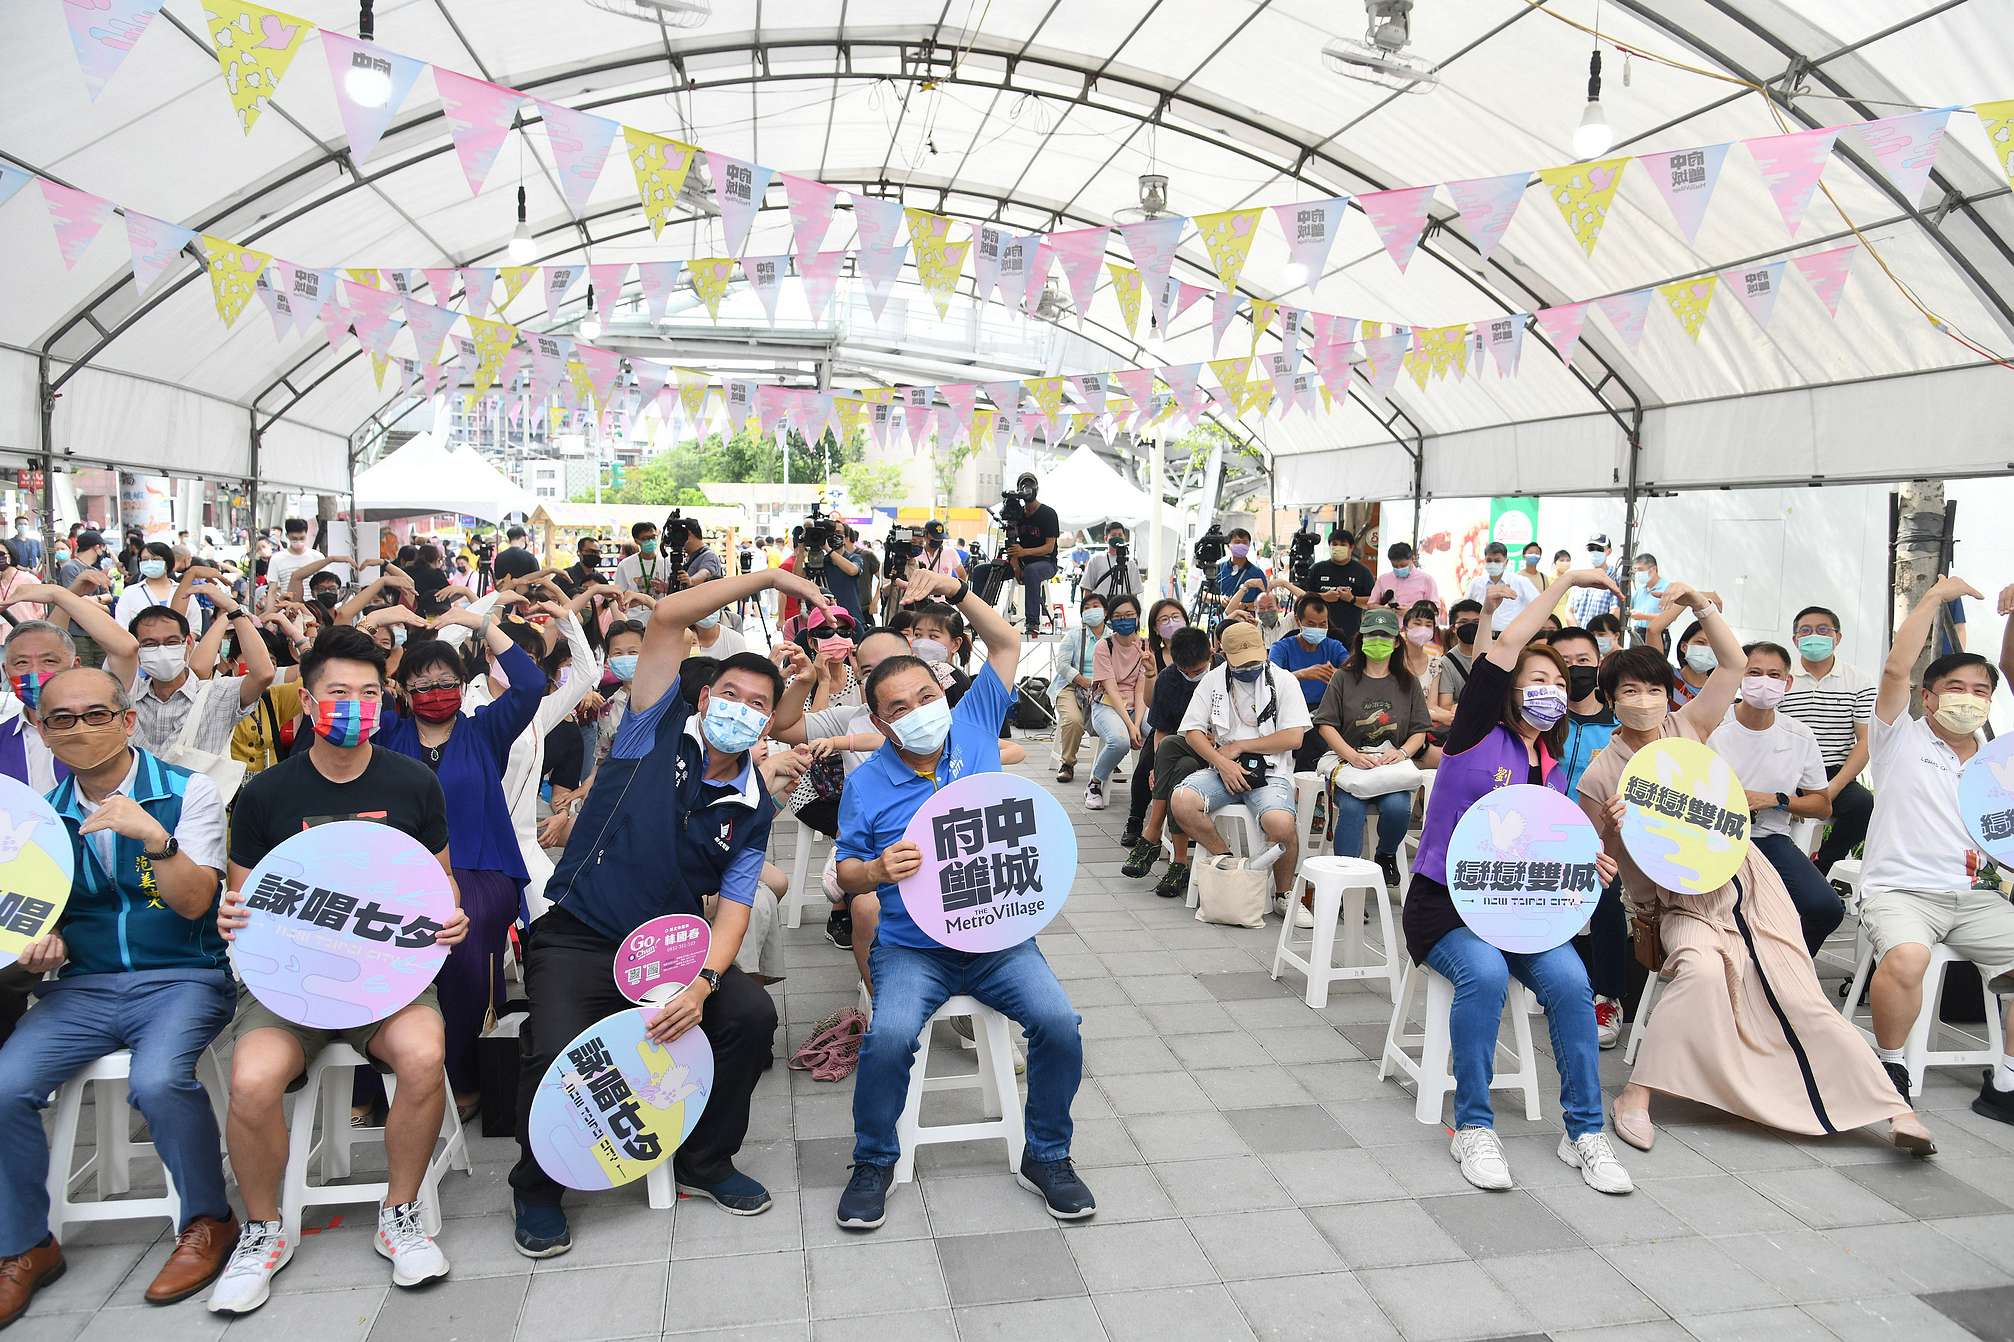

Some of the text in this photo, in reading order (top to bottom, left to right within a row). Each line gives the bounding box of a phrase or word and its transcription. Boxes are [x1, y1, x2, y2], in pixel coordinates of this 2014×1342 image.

[932, 798, 1036, 861] 府中
[1624, 776, 1747, 840] 戀戀雙城
[939, 846, 1043, 912] 雙城
[1453, 860, 1598, 892] 戀戀雙城
[246, 873, 446, 948] 詠唱七夕
[567, 1036, 662, 1161] 詠唱七夕
